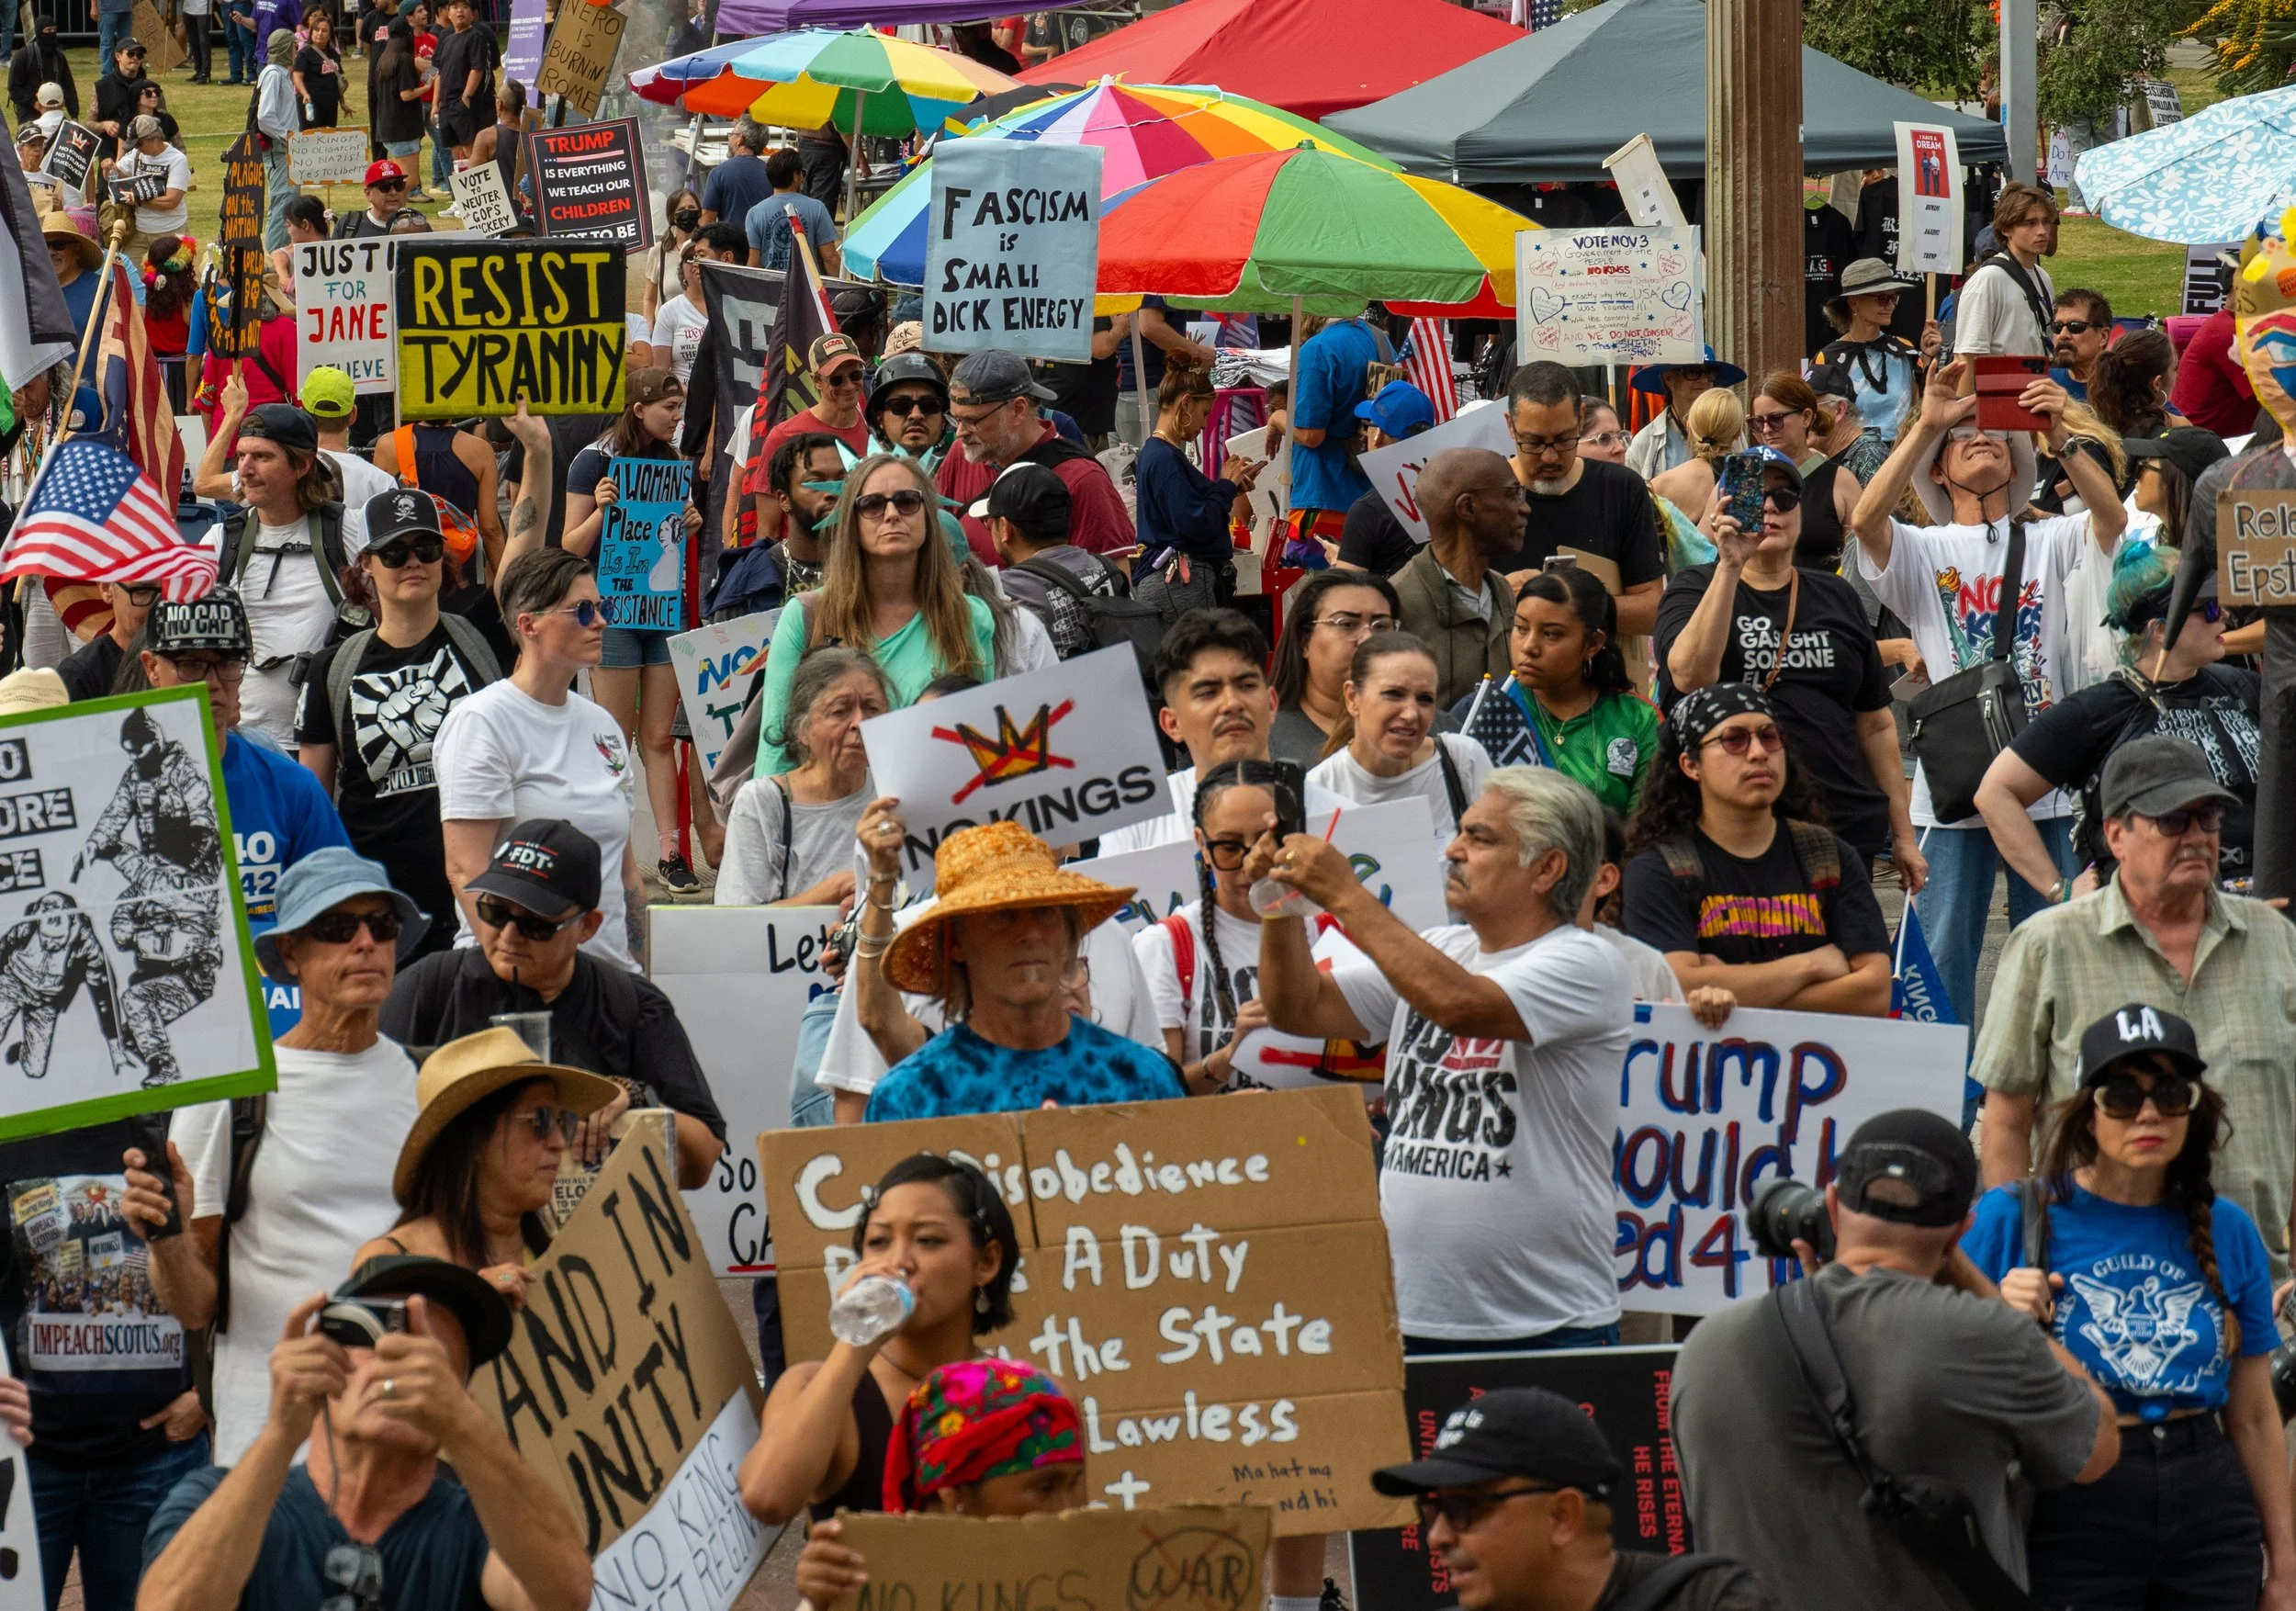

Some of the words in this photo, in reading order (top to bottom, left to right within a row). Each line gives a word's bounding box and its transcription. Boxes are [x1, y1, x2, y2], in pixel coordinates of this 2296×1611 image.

[565, 0, 621, 35] NERO
[577, 28, 595, 48] IS
[542, 67, 600, 113] ROME
[243, 135, 252, 156] A
[291, 136, 310, 144] NO
[545, 130, 614, 153] TRUMP
[1916, 141, 1942, 151] DREAM
[230, 162, 264, 187] PLAGUE
[458, 169, 491, 189] VOTE
[546, 168, 557, 179] IS
[558, 160, 626, 179] EVERYTHING
[471, 186, 481, 196] TO
[547, 186, 567, 197] WE
[567, 182, 604, 197] TEACH
[606, 178, 631, 191] OUR
[226, 196, 239, 216] ON
[462, 189, 501, 211] NEUTER
[551, 197, 631, 220] CHILDREN
[472, 203, 501, 222] GOP'S
[943, 186, 1089, 240] FASCISM
[225, 217, 258, 240] NATION
[617, 223, 636, 239] BE
[1000, 232, 1019, 252] is
[1565, 247, 1622, 259] Government
[1635, 247, 1654, 256] the
[1573, 235, 1608, 250] VOTE
[1611, 234, 1638, 247] NOV
[1639, 234, 1650, 248] 3
[1580, 257, 1615, 265] PEOPLE
[1587, 265, 1602, 276] NO
[941, 258, 1039, 292] SMALL
[324, 280, 366, 300] FOR
[414, 253, 611, 326] RESIST
[307, 303, 388, 343] JANE
[933, 299, 992, 334] DICK
[1002, 297, 1085, 331] ENERGY
[893, 339, 909, 351] ICE
[1563, 332, 1583, 343] AND
[1609, 330, 1622, 339] DO
[1625, 329, 1641, 338] NOT
[403, 328, 625, 409] TYRANNY
[625, 462, 692, 503] WOMANS
[605, 505, 652, 542] Place
[601, 545, 623, 575] Is
[625, 546, 649, 575] In
[612, 577, 634, 592] THE
[166, 604, 191, 636] NO
[194, 603, 231, 635] CAP
[600, 594, 678, 627] SISTANCE
[1737, 615, 1772, 633] GO
[2115, 1006, 2165, 1043] LA
[950, 1142, 1270, 1205] isobedience
[1613, 1121, 1795, 1211] ould
[602, 1144, 692, 1316] IN
[1062, 1225, 1102, 1292] A
[2092, 1253, 2156, 1279] GUILD
[2159, 1259, 2188, 1282] OF
[32, 1324, 181, 1361] IMPEACHSCOTUS.org
[1030, 1314, 1131, 1381] the
[1156, 1301, 1333, 1365] State
[1083, 1389, 1300, 1455] Lawless
[1637, 1479, 1658, 1539] RISES
[1131, 1551, 1244, 1604] WAR
